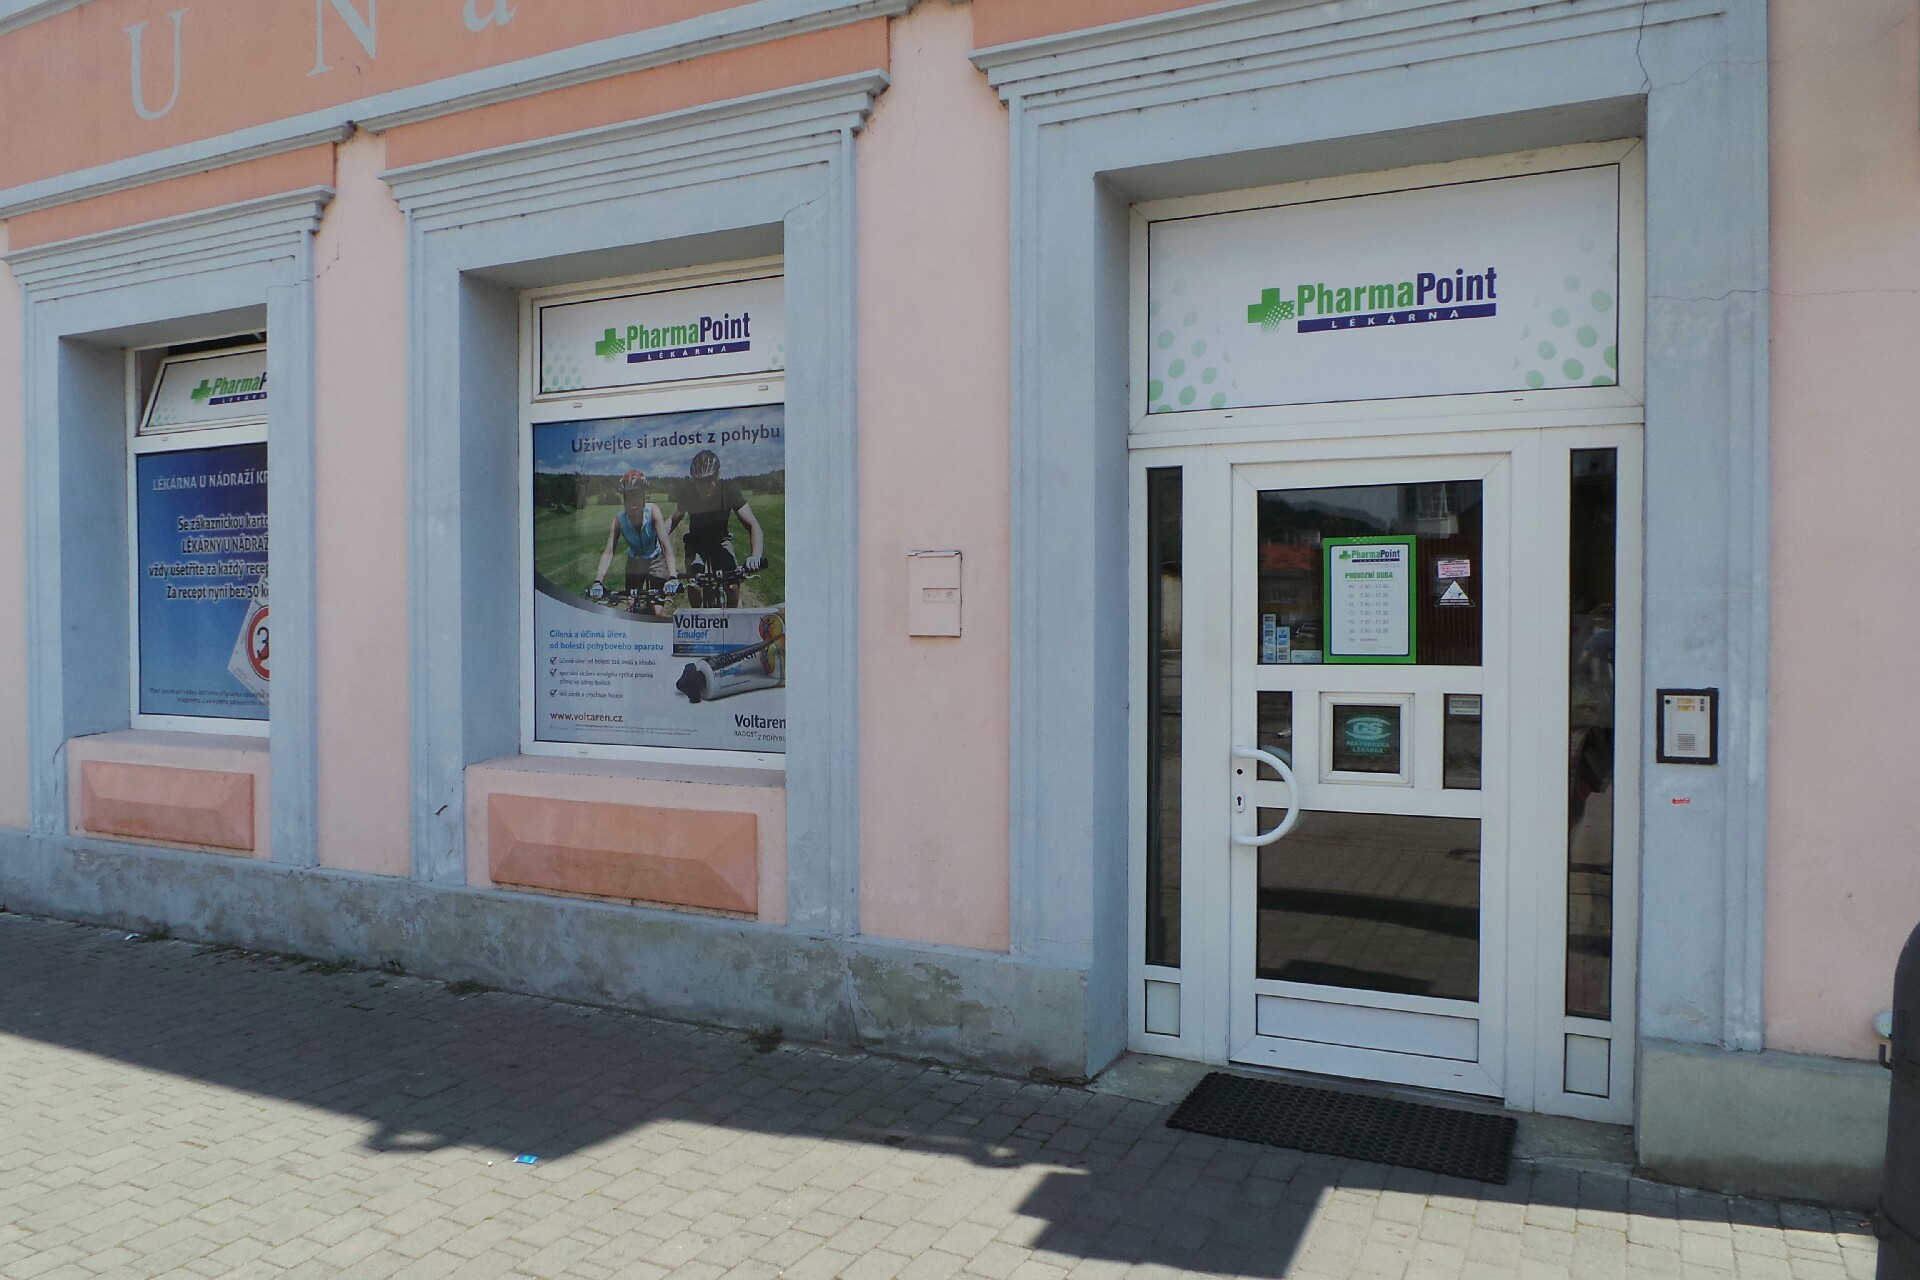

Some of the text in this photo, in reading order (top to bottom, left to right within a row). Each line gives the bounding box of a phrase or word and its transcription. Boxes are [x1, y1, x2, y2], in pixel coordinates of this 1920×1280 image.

[122, 7, 190, 121] U
[1298, 266, 1497, 316] PharmaPoint
[1331, 309, 1459, 329] LÉKÁRNA
[626, 312, 751, 351] PharmaPoint
[648, 345, 727, 360] LÉKÁRNA
[571, 424, 780, 454] Užívejte si radost z pohybu
[153, 475, 197, 491] LÉKÁRNA
[199, 476, 206, 488] U
[209, 468, 255, 487] NÁDRAŽÍ
[178, 516, 189, 531] Se
[191, 514, 244, 530] zákaznickou
[182, 536, 221, 554] LÉKÁRNY
[223, 538, 230, 552] U
[1351, 549, 1400, 559] PharmaPoint
[149, 563, 169, 580] vždy
[170, 562, 205, 577] ušetříte
[207, 566, 216, 576] za
[218, 560, 244, 579] každý
[166, 586, 176, 599] Za
[178, 587, 206, 602] recept
[208, 585, 228, 602] nyní
[230, 584, 245, 598] bez
[247, 585, 259, 598] 30
[674, 614, 729, 629] Voltaren
[560, 642, 585, 650] bolesti
[549, 712, 624, 723] www.voltaren.cz
[734, 714, 786, 729] Voltaren
